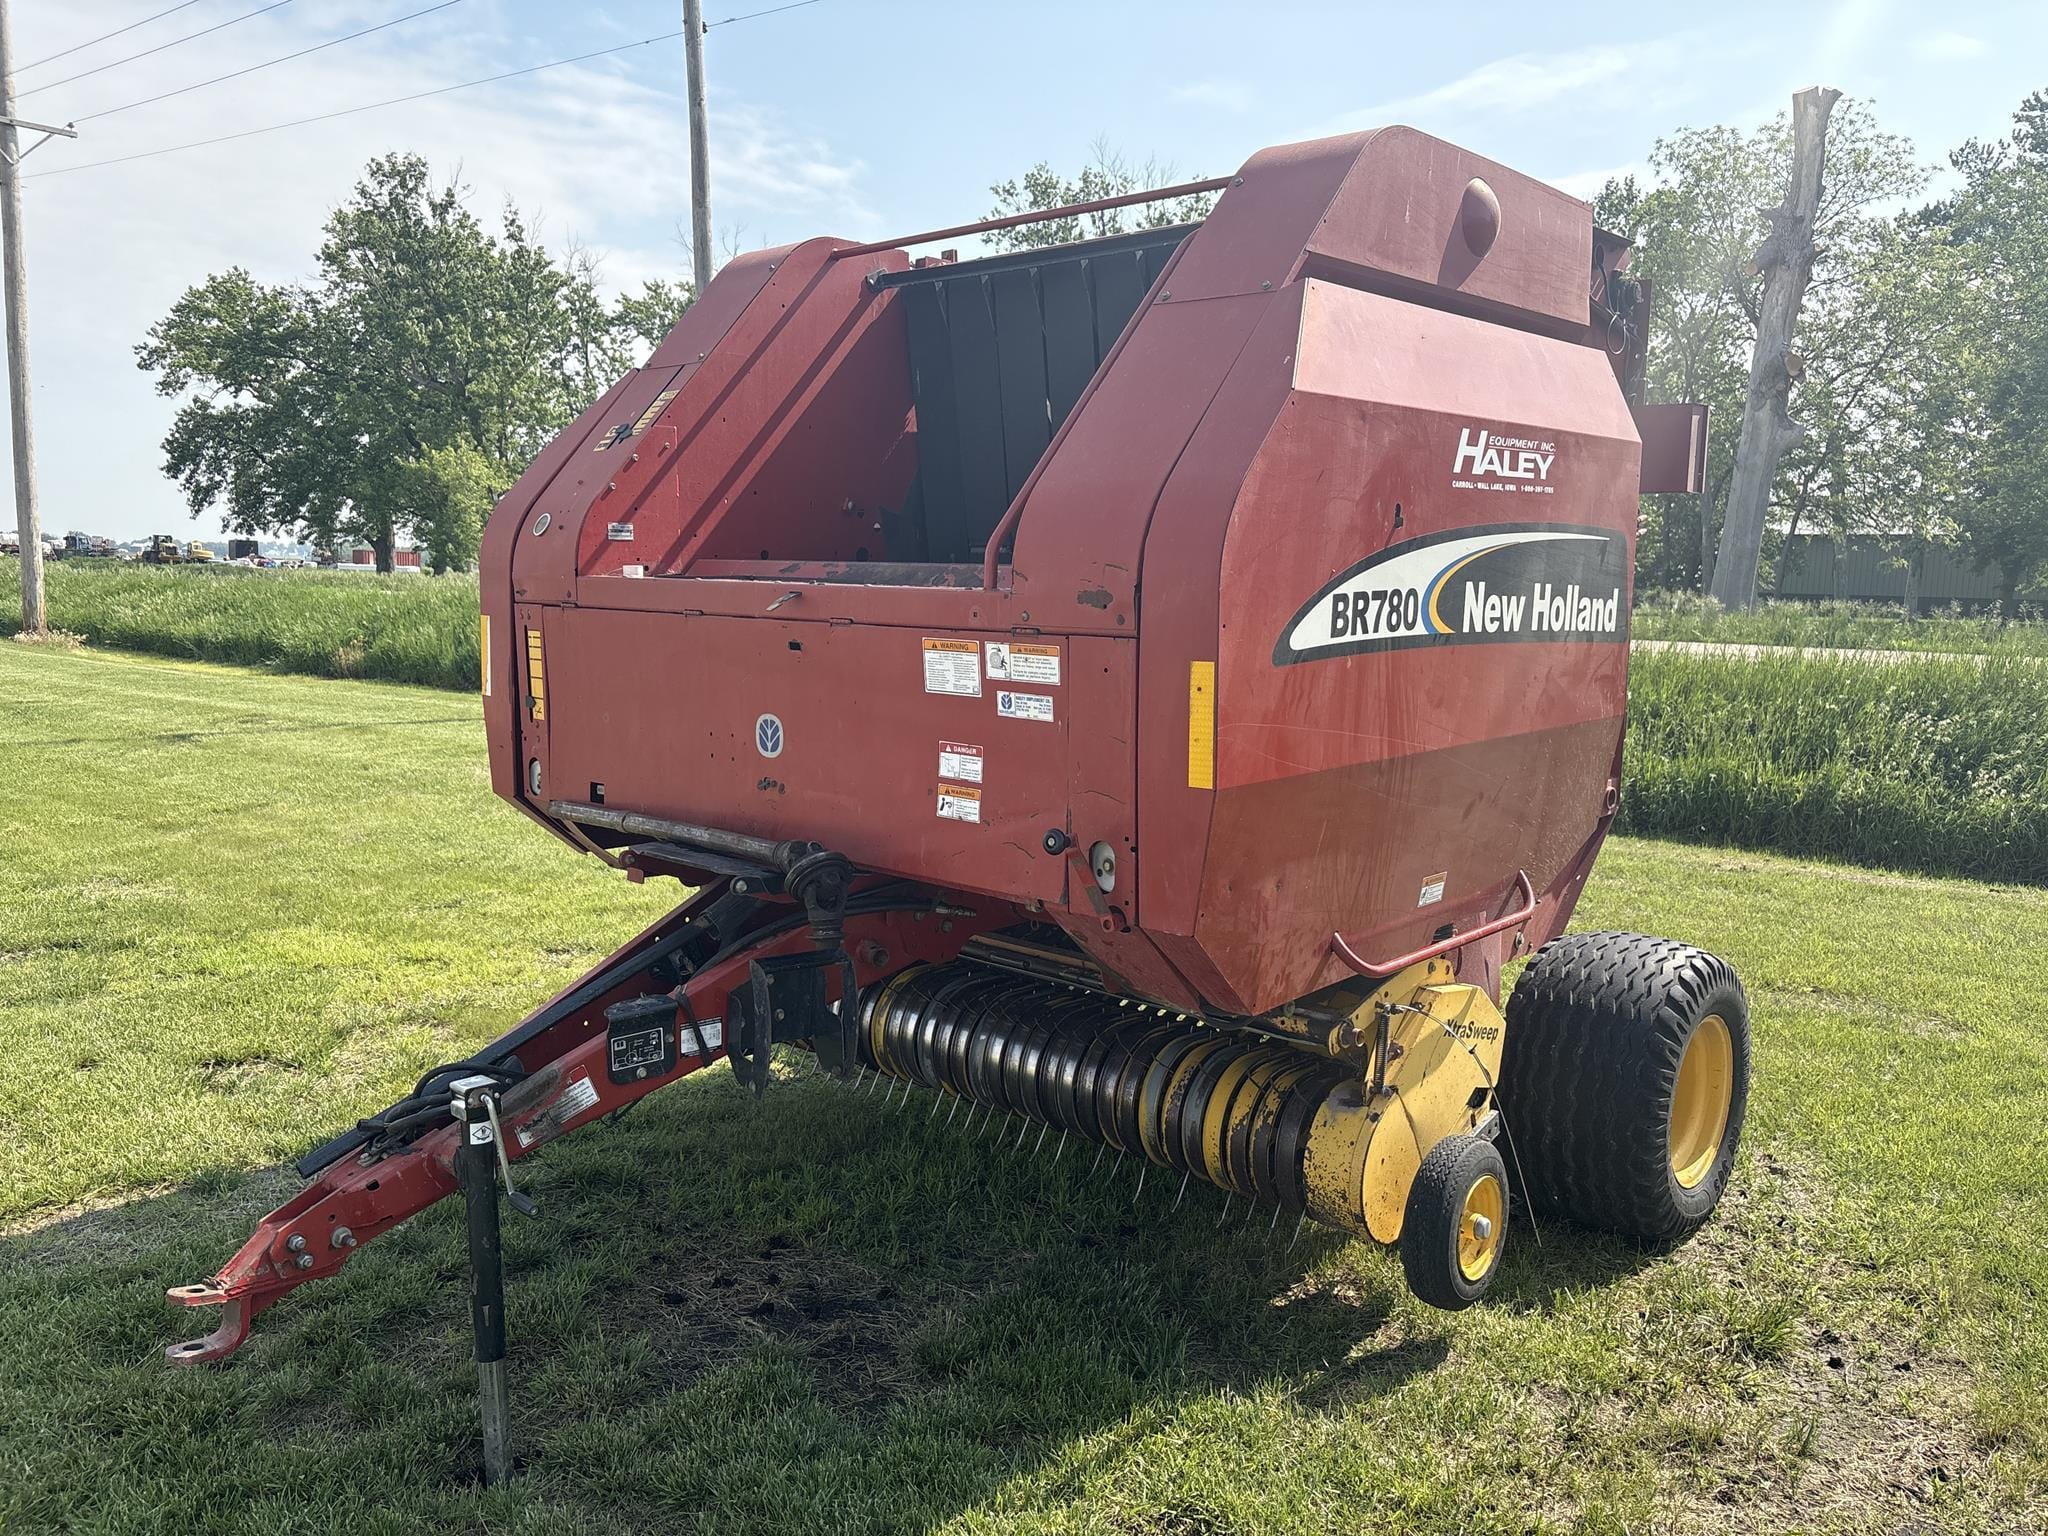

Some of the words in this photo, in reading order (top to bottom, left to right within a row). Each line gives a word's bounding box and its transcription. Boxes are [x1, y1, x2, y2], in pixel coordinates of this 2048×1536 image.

[1489, 436, 1538, 449] EQUIPMENT
[1540, 442, 1556, 452] INC.
[1453, 428, 1555, 480] HALEY
[1452, 480, 1474, 489] CARROLL
[1477, 482, 1489, 490] WALL
[1330, 588, 1419, 639] BR780
[1462, 581, 1526, 634] New
[1531, 582, 1620, 633] Holland
[939, 642, 969, 651] WARNING
[953, 745, 977, 755] DANGER
[951, 789, 976, 798] WARNING
[1443, 1018, 1499, 1045] XtraSweep
